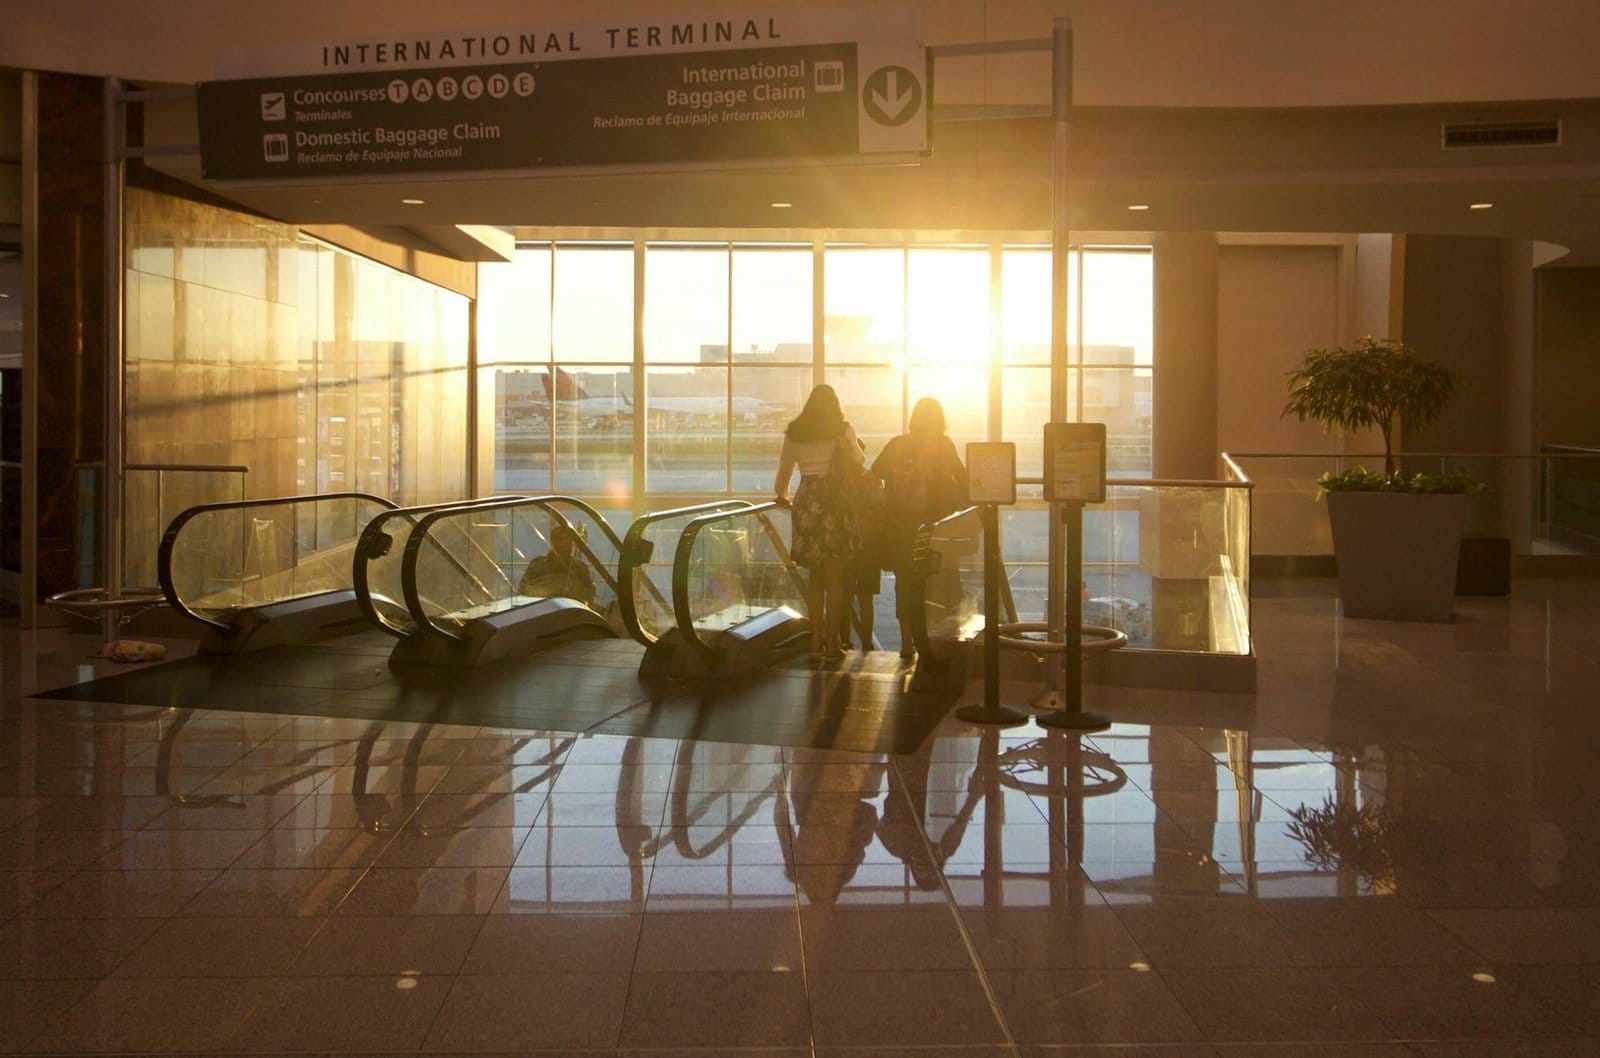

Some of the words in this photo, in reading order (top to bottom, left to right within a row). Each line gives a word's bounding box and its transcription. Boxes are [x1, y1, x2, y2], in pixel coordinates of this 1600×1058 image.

[323, 32, 581, 66] INTERNATIONAL
[606, 18, 781, 48] TERMINAL
[683, 60, 805, 83] International
[293, 88, 387, 105] Concourses
[667, 89, 747, 108] Baggage
[753, 83, 806, 101] Claim
[295, 109, 352, 122] Terminales
[593, 115, 644, 129] Reclamo
[647, 114, 662, 126] de
[665, 111, 718, 126] Equipaje
[722, 107, 805, 122] Internacional
[296, 128, 371, 147] Domestic
[375, 127, 448, 146] Baggage
[453, 122, 501, 140] Claim
[297, 150, 342, 164] Reclamo
[346, 149, 360, 162] de
[362, 148, 410, 164] Equipaje
[413, 146, 462, 159] Nacional
